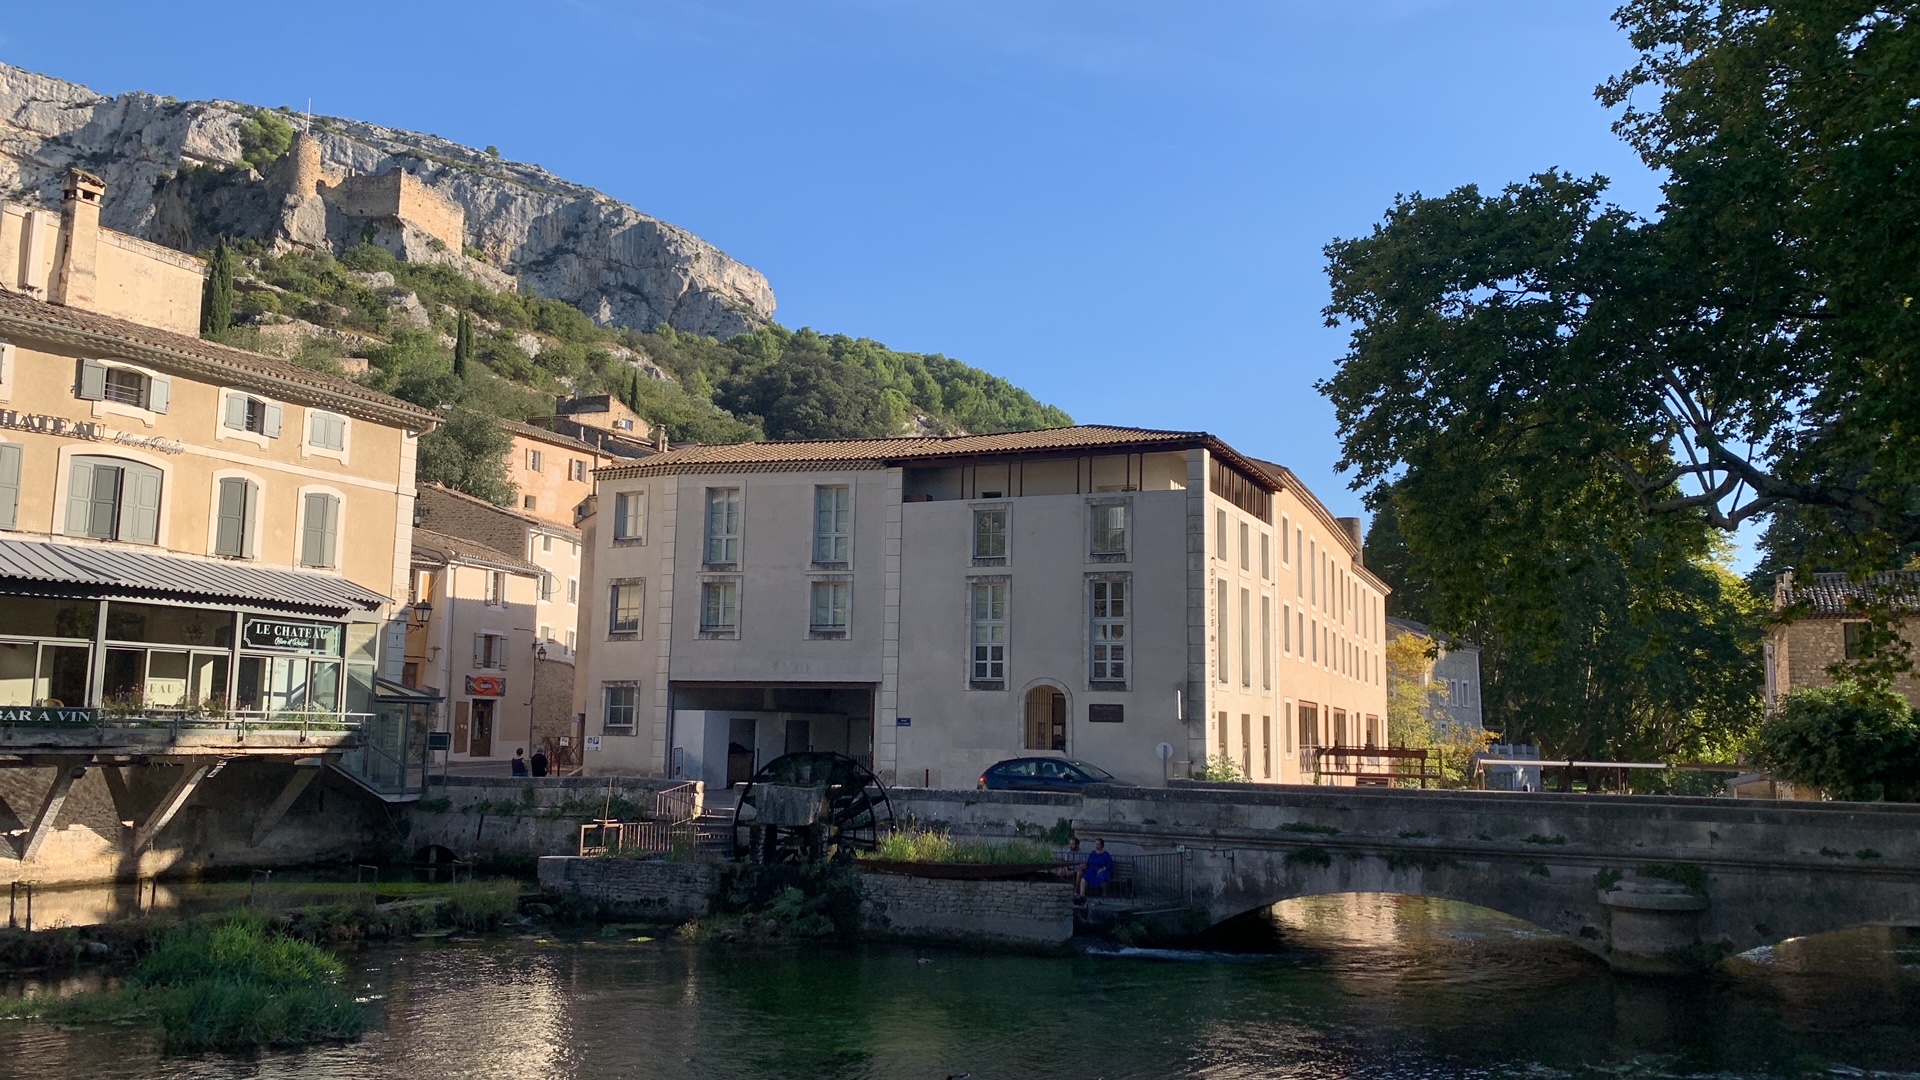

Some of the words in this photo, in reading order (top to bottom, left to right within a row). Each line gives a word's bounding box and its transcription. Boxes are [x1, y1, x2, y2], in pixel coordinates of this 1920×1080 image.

[256, 623, 271, 635] LE
[274, 625, 328, 640] CHATEAU
[37, 710, 51, 721] A
[56, 710, 92, 722] VIN
